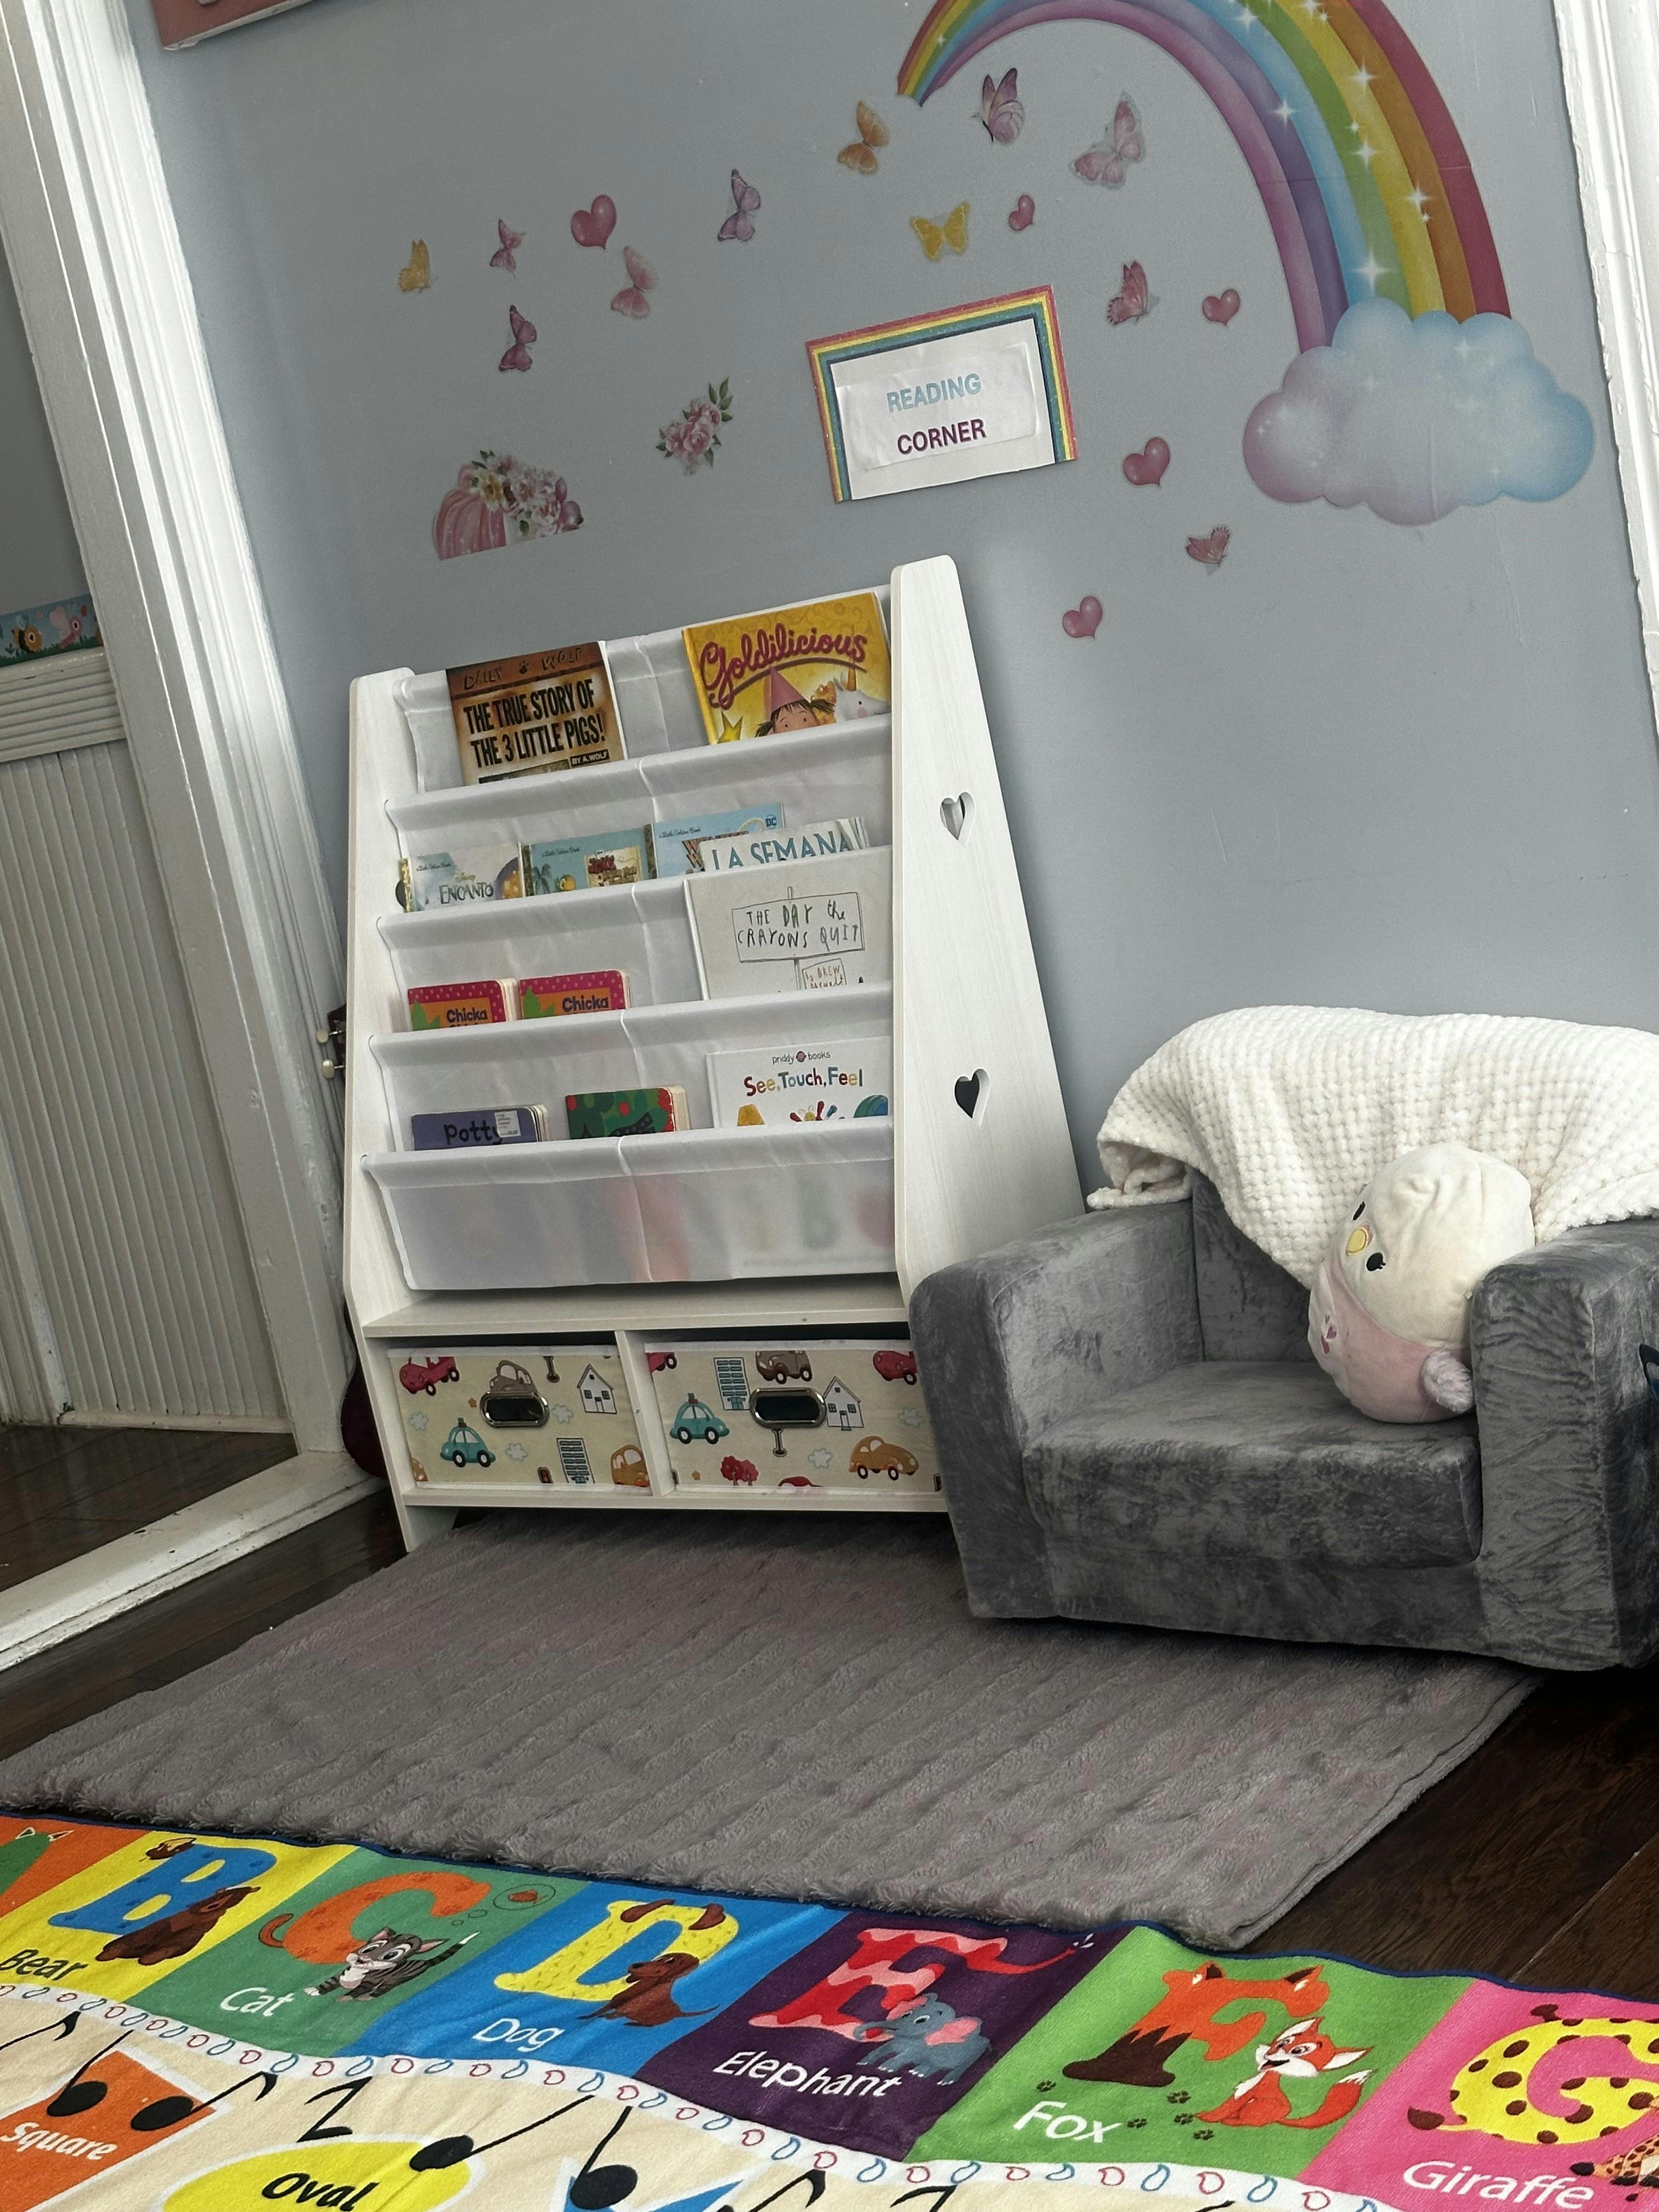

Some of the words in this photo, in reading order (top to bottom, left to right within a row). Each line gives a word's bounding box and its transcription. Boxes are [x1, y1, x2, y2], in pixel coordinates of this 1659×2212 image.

[886, 373, 982, 413] READING
[897, 417, 988, 455] CORNER
[699, 622, 867, 710] Goldilicious
[463, 702, 494, 735] THE
[492, 691, 533, 728] TRUE
[529, 682, 577, 720] STORY
[576, 678, 594, 710] OF
[470, 735, 502, 769] THE
[501, 733, 515, 762] 3
[514, 722, 565, 760] LITTLE
[563, 712, 606, 749] PIGS!
[765, 815, 777, 827] DC
[750, 830, 853, 865] SEMANA
[439, 881, 494, 905] ENCANTO
[746, 909, 770, 926] THE
[782, 904, 814, 928] DAY
[827, 899, 846, 922] the
[737, 928, 808, 949] CRAYONS
[820, 924, 859, 952] QUIT
[817, 964, 840, 978] DREW
[446, 1006, 488, 1024] Chicka
[561, 995, 609, 1013] Chicka
[771, 1054, 794, 1065] priddy
[807, 1051, 831, 1060] books
[827, 1066, 863, 1087] Feel
[0, 1949, 89, 1981] Bear
[220, 1987, 295, 2017] Cat
[472, 2018, 565, 2052] Dog
[712, 2050, 915, 2098] Elephant
[1013, 2100, 1124, 2145] Fox
[1, 2121, 118, 2161] Square
[261, 2172, 381, 2212] Oval
[1402, 2159, 1595, 2209] Giraffe
